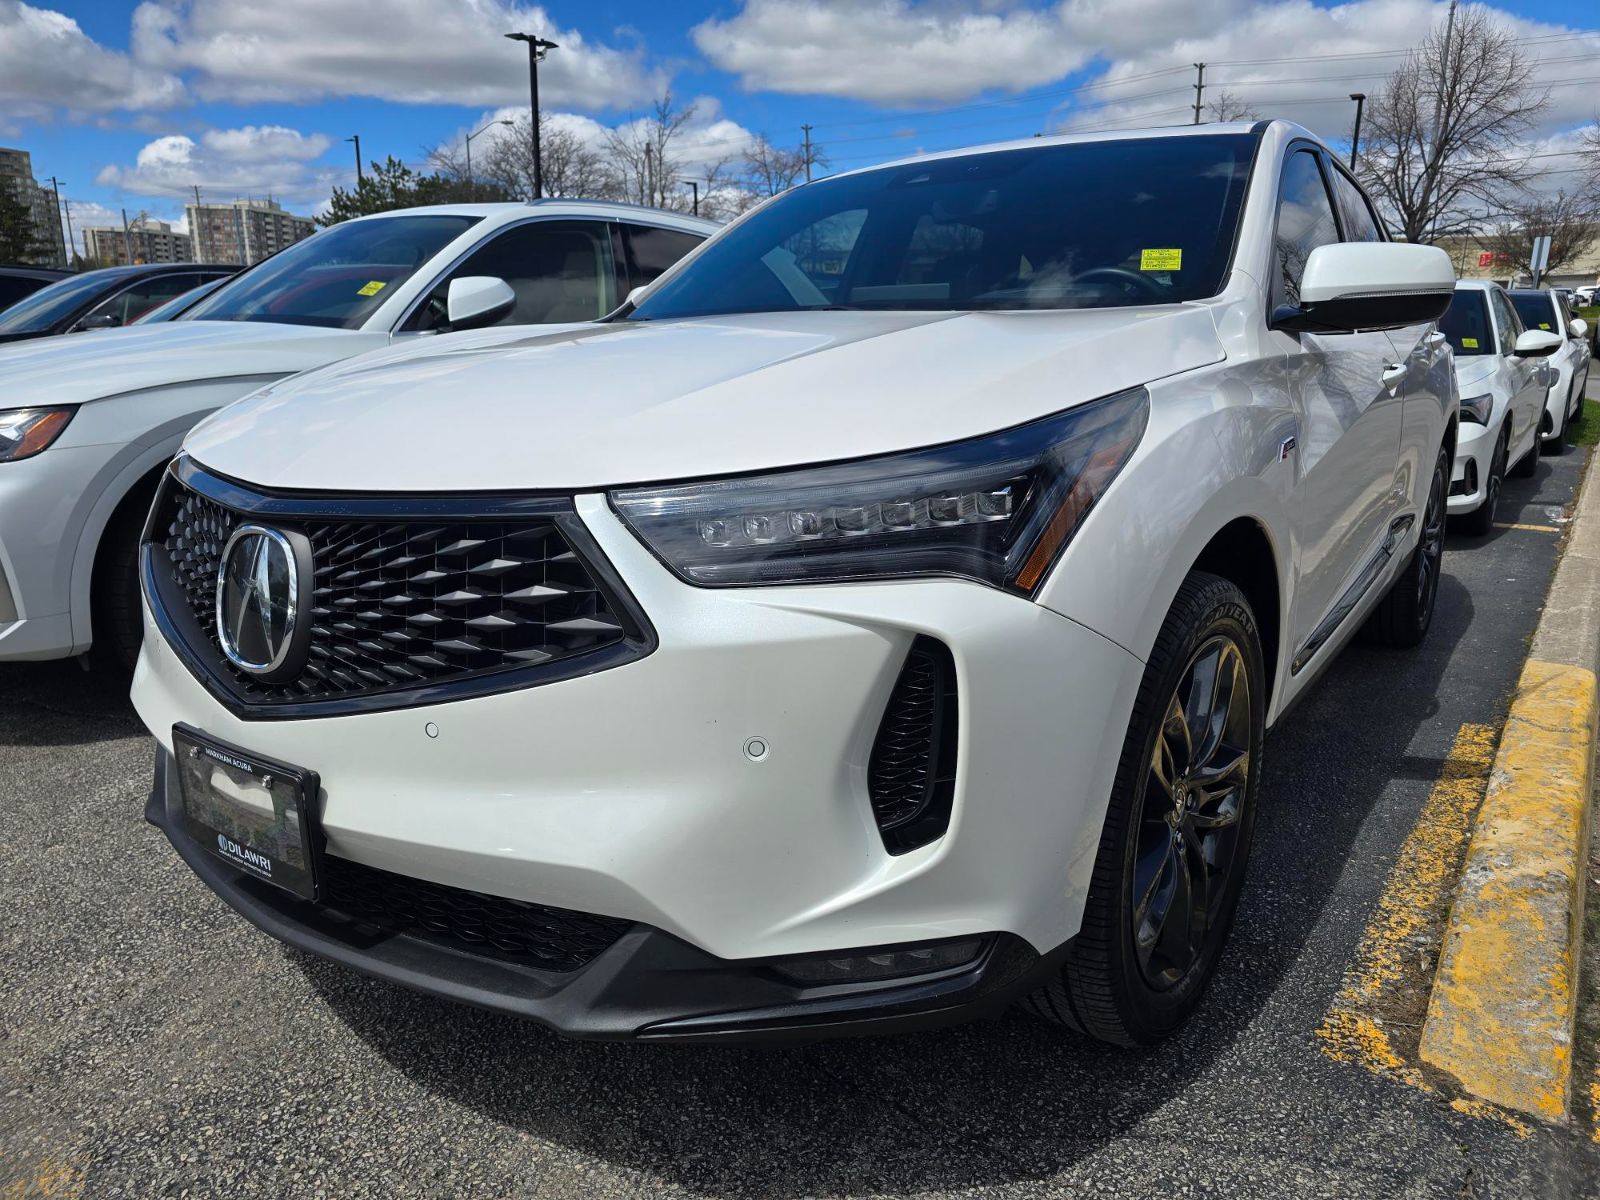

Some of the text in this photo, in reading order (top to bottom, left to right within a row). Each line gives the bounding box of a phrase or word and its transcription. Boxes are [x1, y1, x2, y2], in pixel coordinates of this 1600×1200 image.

[205, 748, 253, 773] MARKHAM ACURA
[228, 840, 271, 871] DILAWRI
